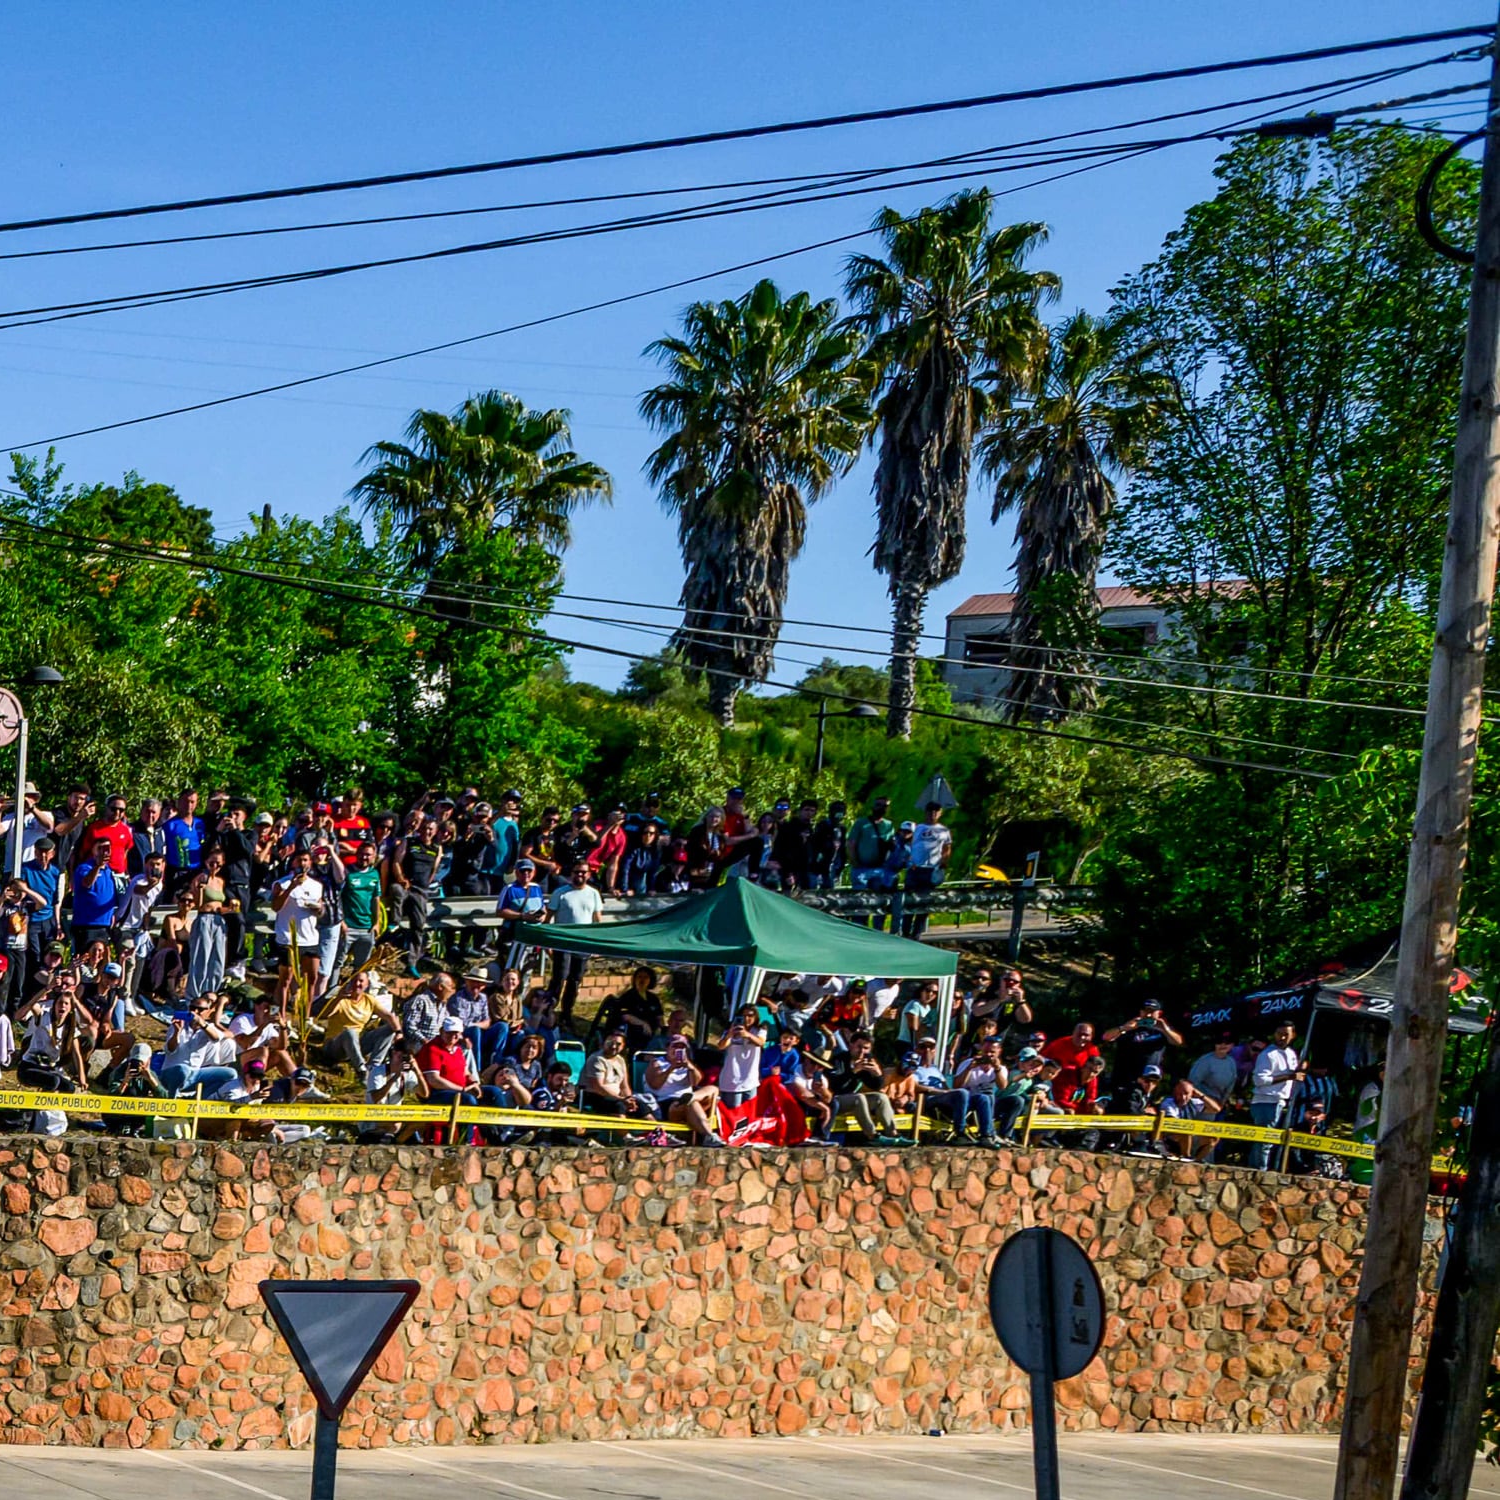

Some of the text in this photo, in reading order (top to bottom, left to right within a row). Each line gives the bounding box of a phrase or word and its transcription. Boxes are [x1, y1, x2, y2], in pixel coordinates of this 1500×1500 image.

[34, 1095, 60, 1106] ZONA
[62, 1097, 102, 1109] PUBLICO
[111, 1100, 136, 1110] ZONA
[138, 1101, 178, 1113] PUBLICO
[1291, 1136, 1321, 1148] UBLICO
[1330, 1141, 1353, 1152] ZONA
